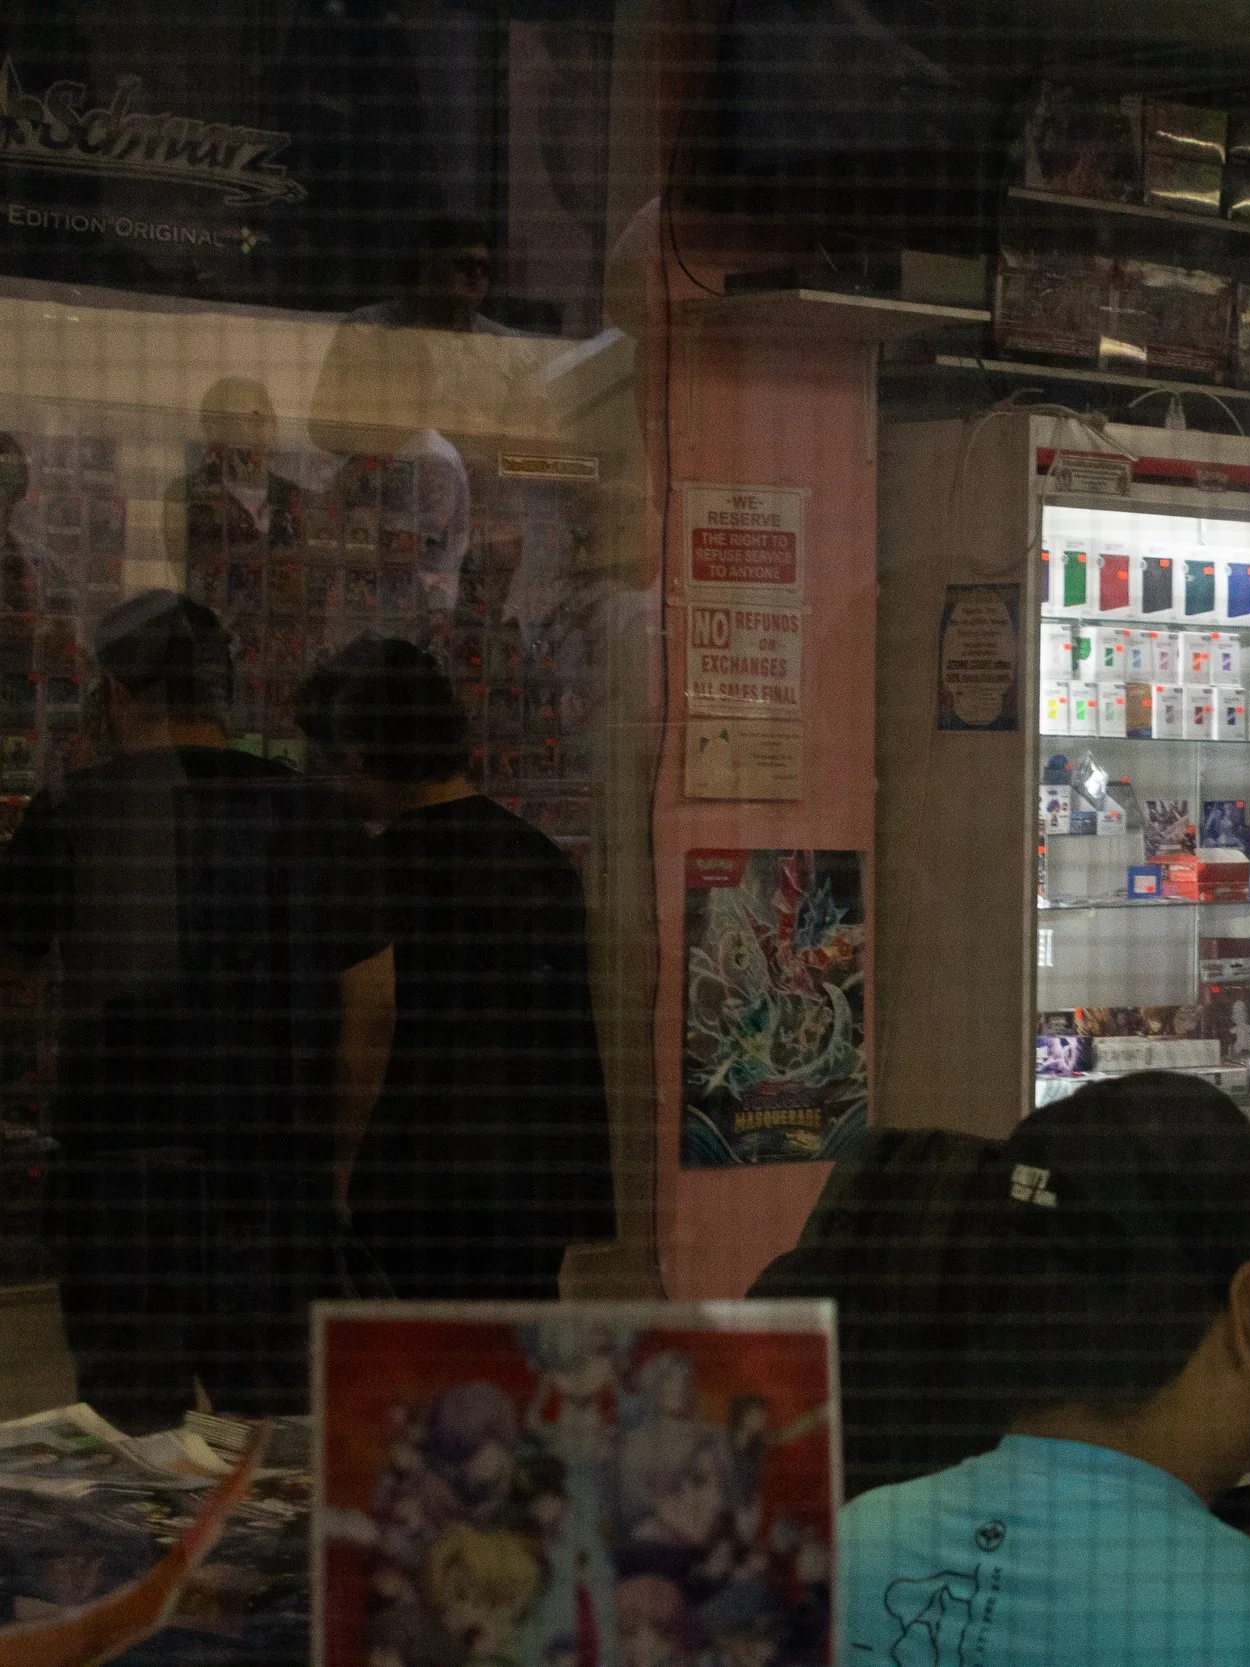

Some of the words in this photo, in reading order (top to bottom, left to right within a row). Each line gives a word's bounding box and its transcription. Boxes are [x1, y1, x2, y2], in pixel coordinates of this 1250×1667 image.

[707, 510, 782, 528] RESERVE
[702, 532, 727, 548] THE
[730, 533, 768, 549] RIGHT
[772, 534, 788, 549] TO
[708, 563, 727, 578] TO
[729, 565, 781, 581] ANYONE
[693, 610, 729, 647] NO
[735, 611, 799, 634] REFUNDS
[701, 654, 787, 679] EXCHANGES
[761, 685, 798, 705] FINAL
